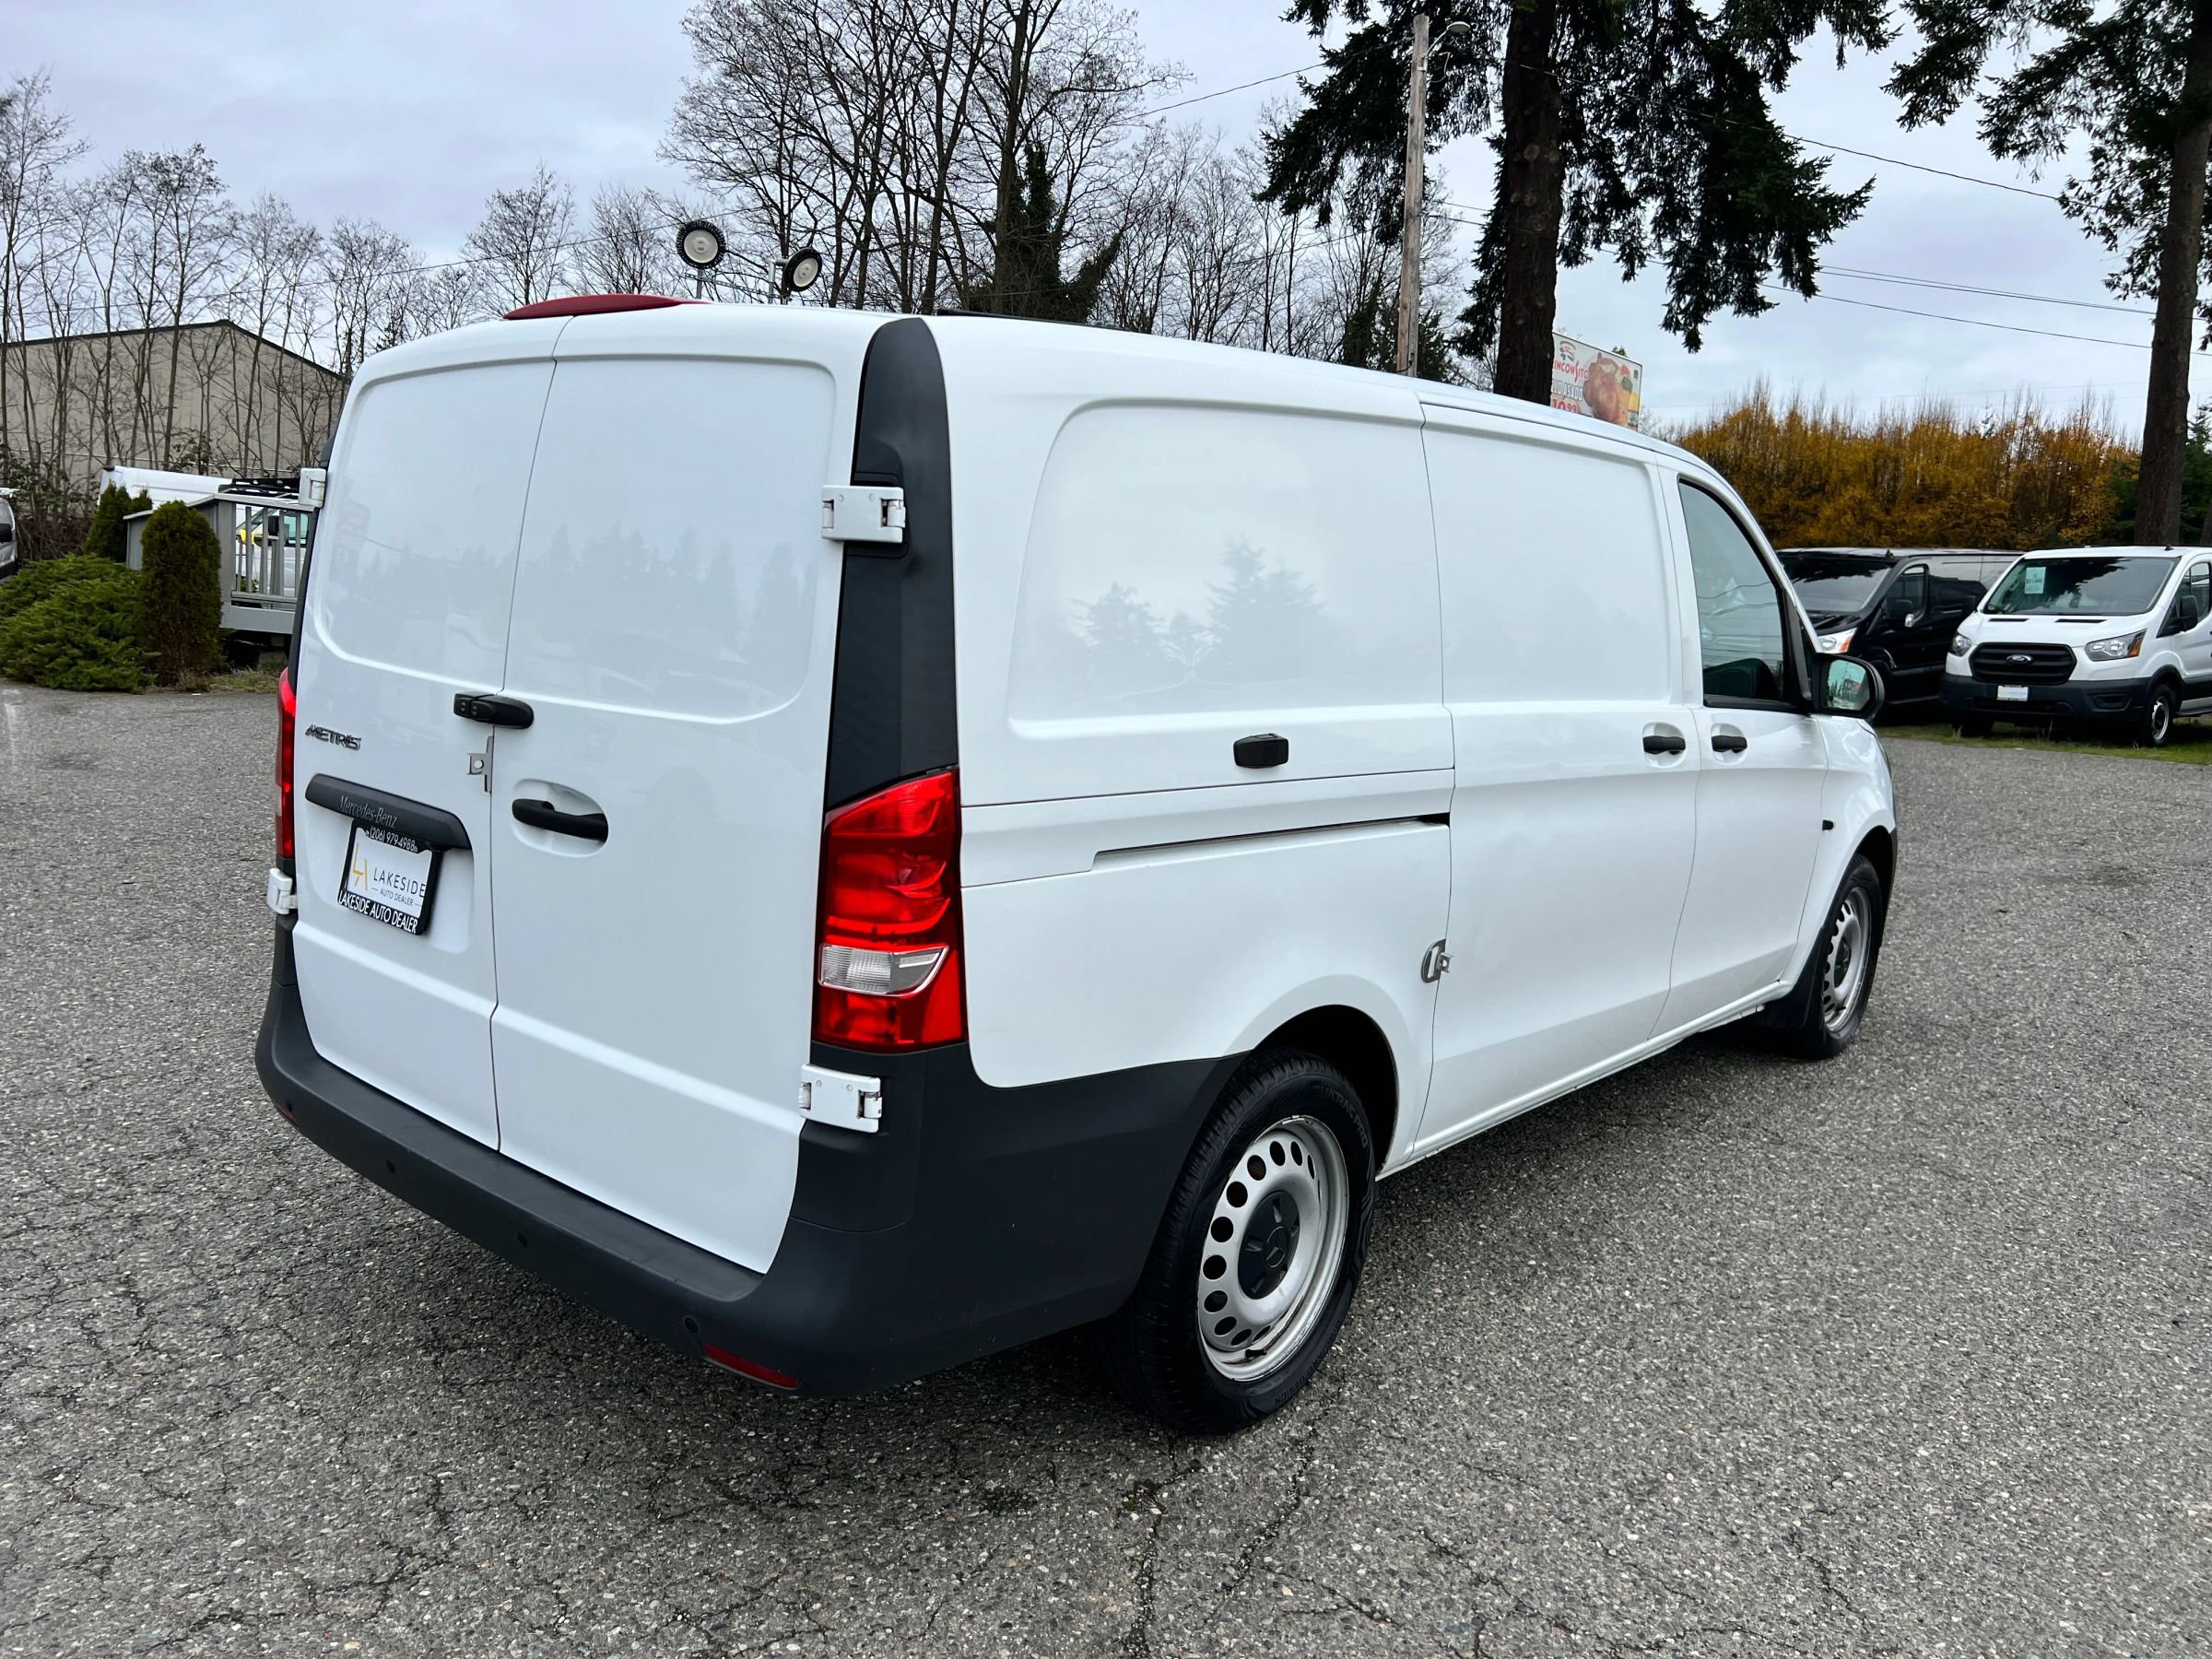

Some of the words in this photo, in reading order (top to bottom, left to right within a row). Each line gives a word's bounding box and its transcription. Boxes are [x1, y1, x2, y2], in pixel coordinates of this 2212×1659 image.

[305, 724, 361, 751] METRIS
[338, 795, 398, 828] Mercedes-Benz
[386, 831, 416, 852] 979-4988
[373, 867, 426, 898] LAKESIDE
[339, 889, 371, 914] LAKESIDE
[370, 901, 392, 923] AUTO
[391, 910, 418, 934] DEALER
[380, 888, 394, 900] AUTO
[394, 892, 414, 907] DEALER
